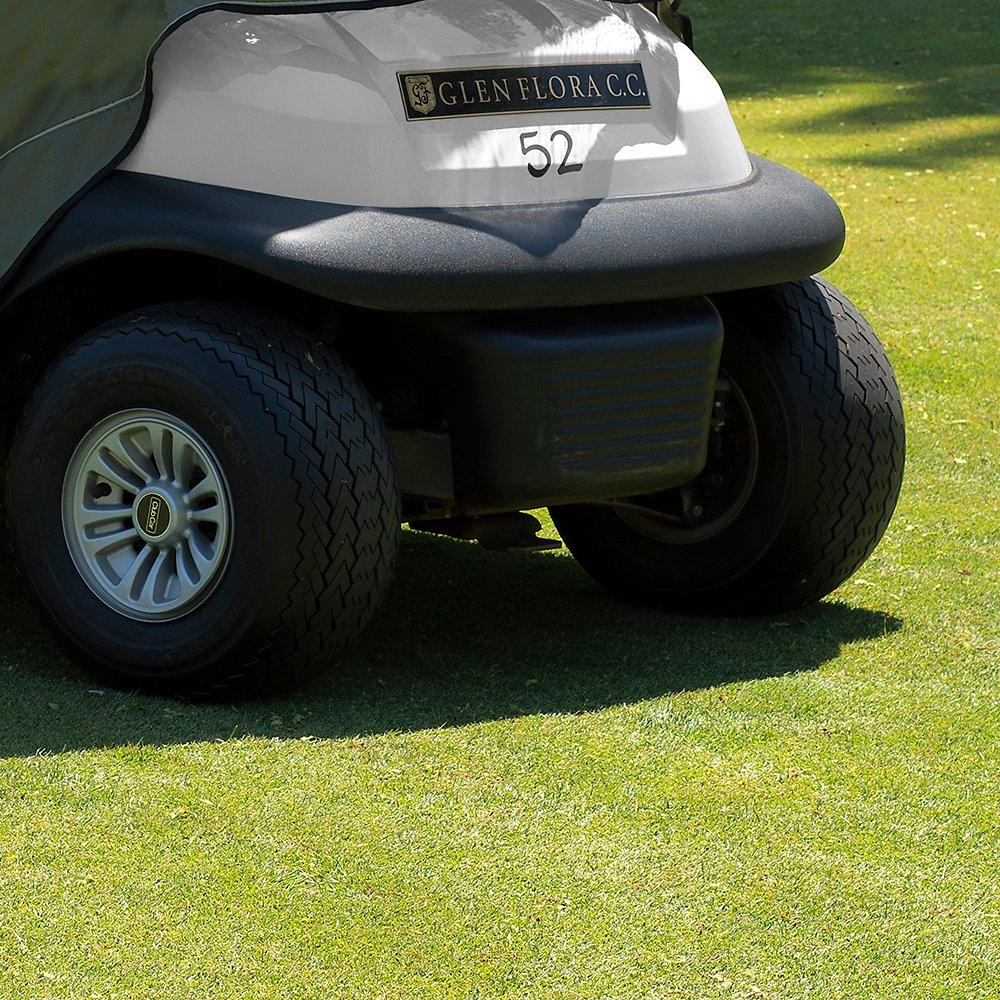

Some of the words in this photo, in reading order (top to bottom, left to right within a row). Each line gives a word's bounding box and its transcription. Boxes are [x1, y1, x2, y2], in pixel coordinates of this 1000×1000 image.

[438, 79, 512, 105] GLEN
[516, 74, 603, 101] FLORA
[606, 73, 647, 97] C.C.
[519, 129, 583, 178] 52
